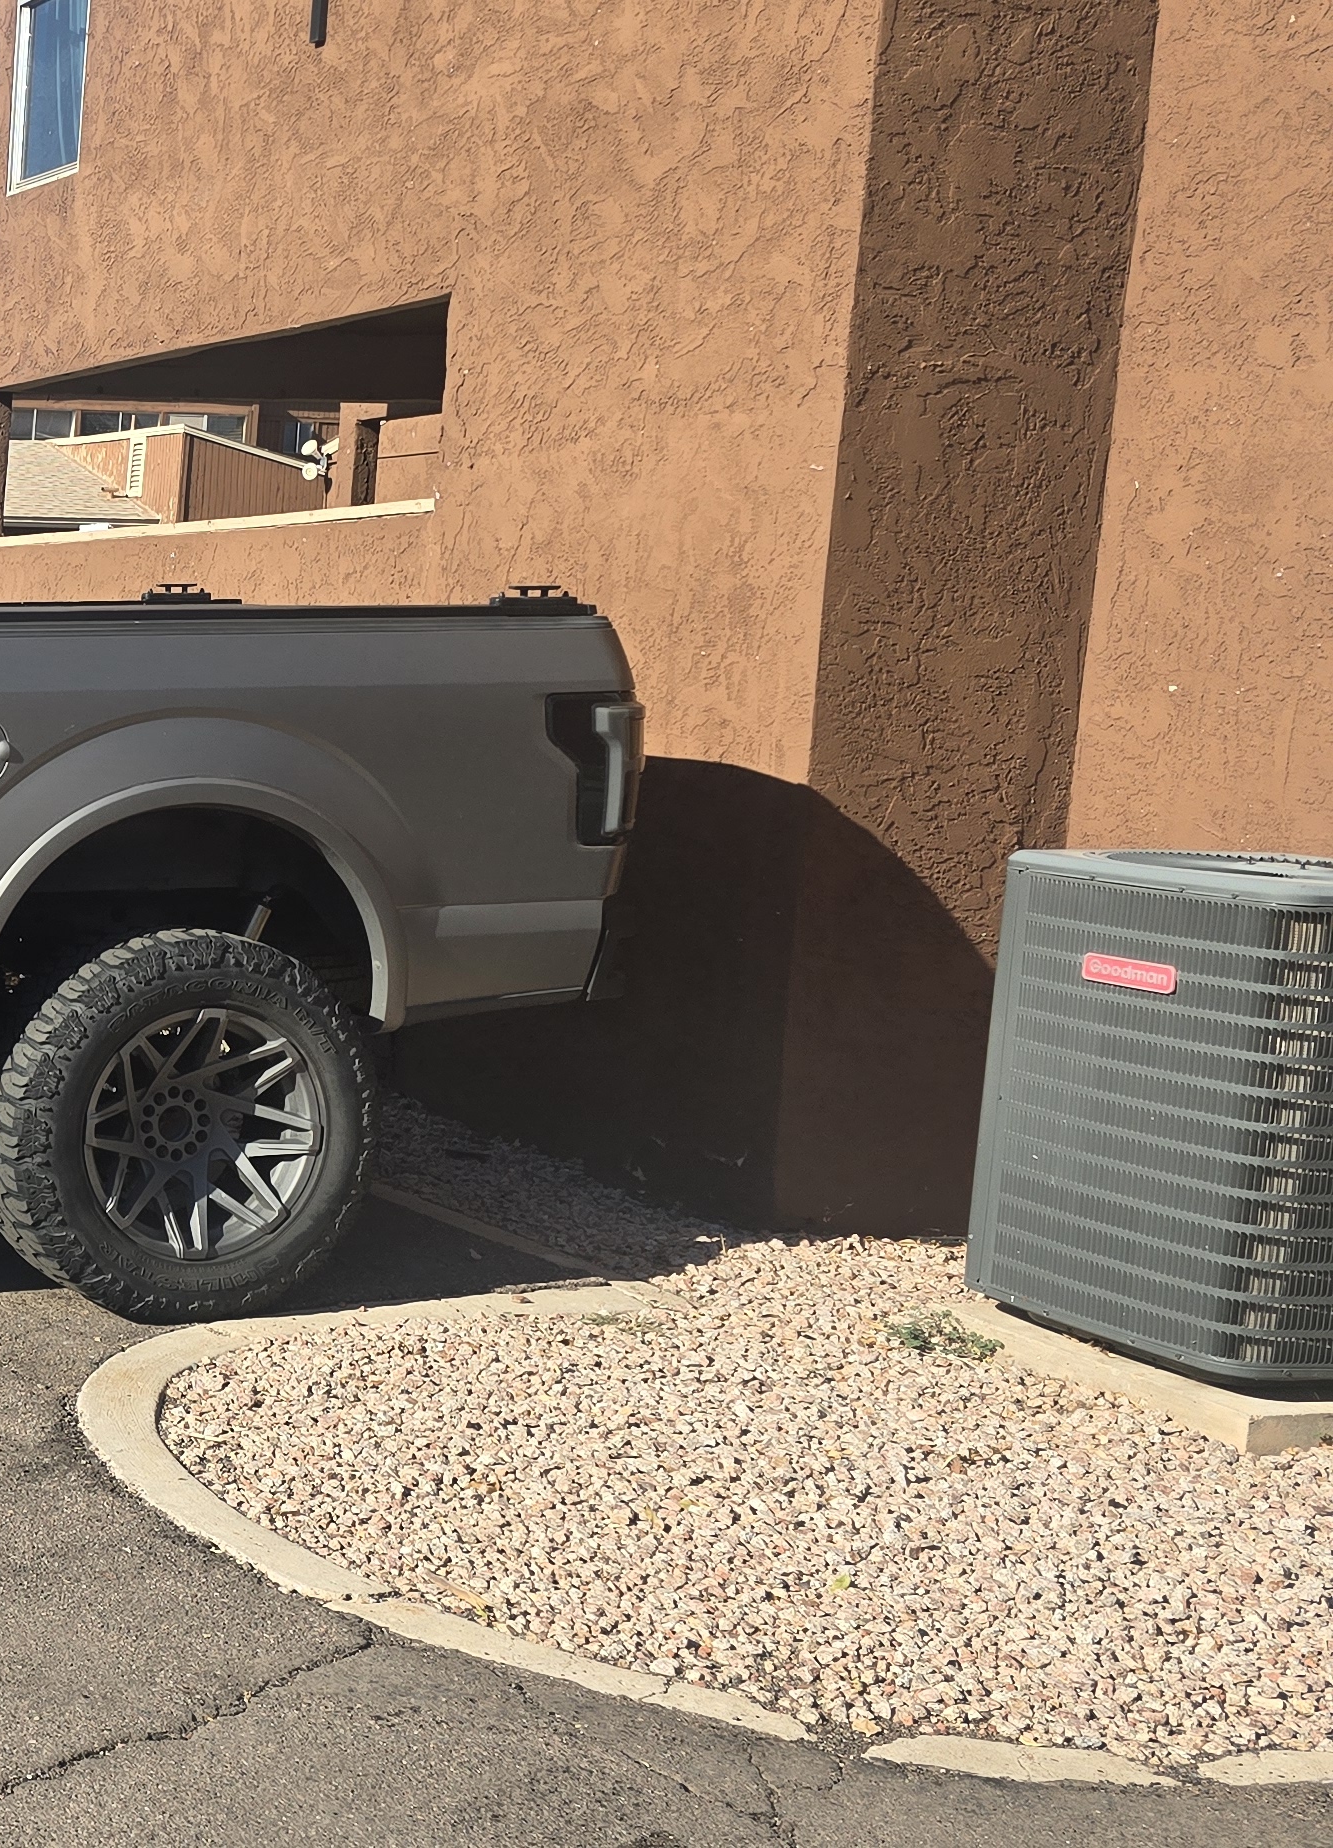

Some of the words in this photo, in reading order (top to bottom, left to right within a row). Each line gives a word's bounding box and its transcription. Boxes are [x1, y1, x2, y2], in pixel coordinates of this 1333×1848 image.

[1088, 959, 1169, 986] Goodman
[107, 976, 289, 1033] PATAGONIA
[293, 1006, 338, 1055] M/T
[98, 1242, 259, 1292] MILESTAR
